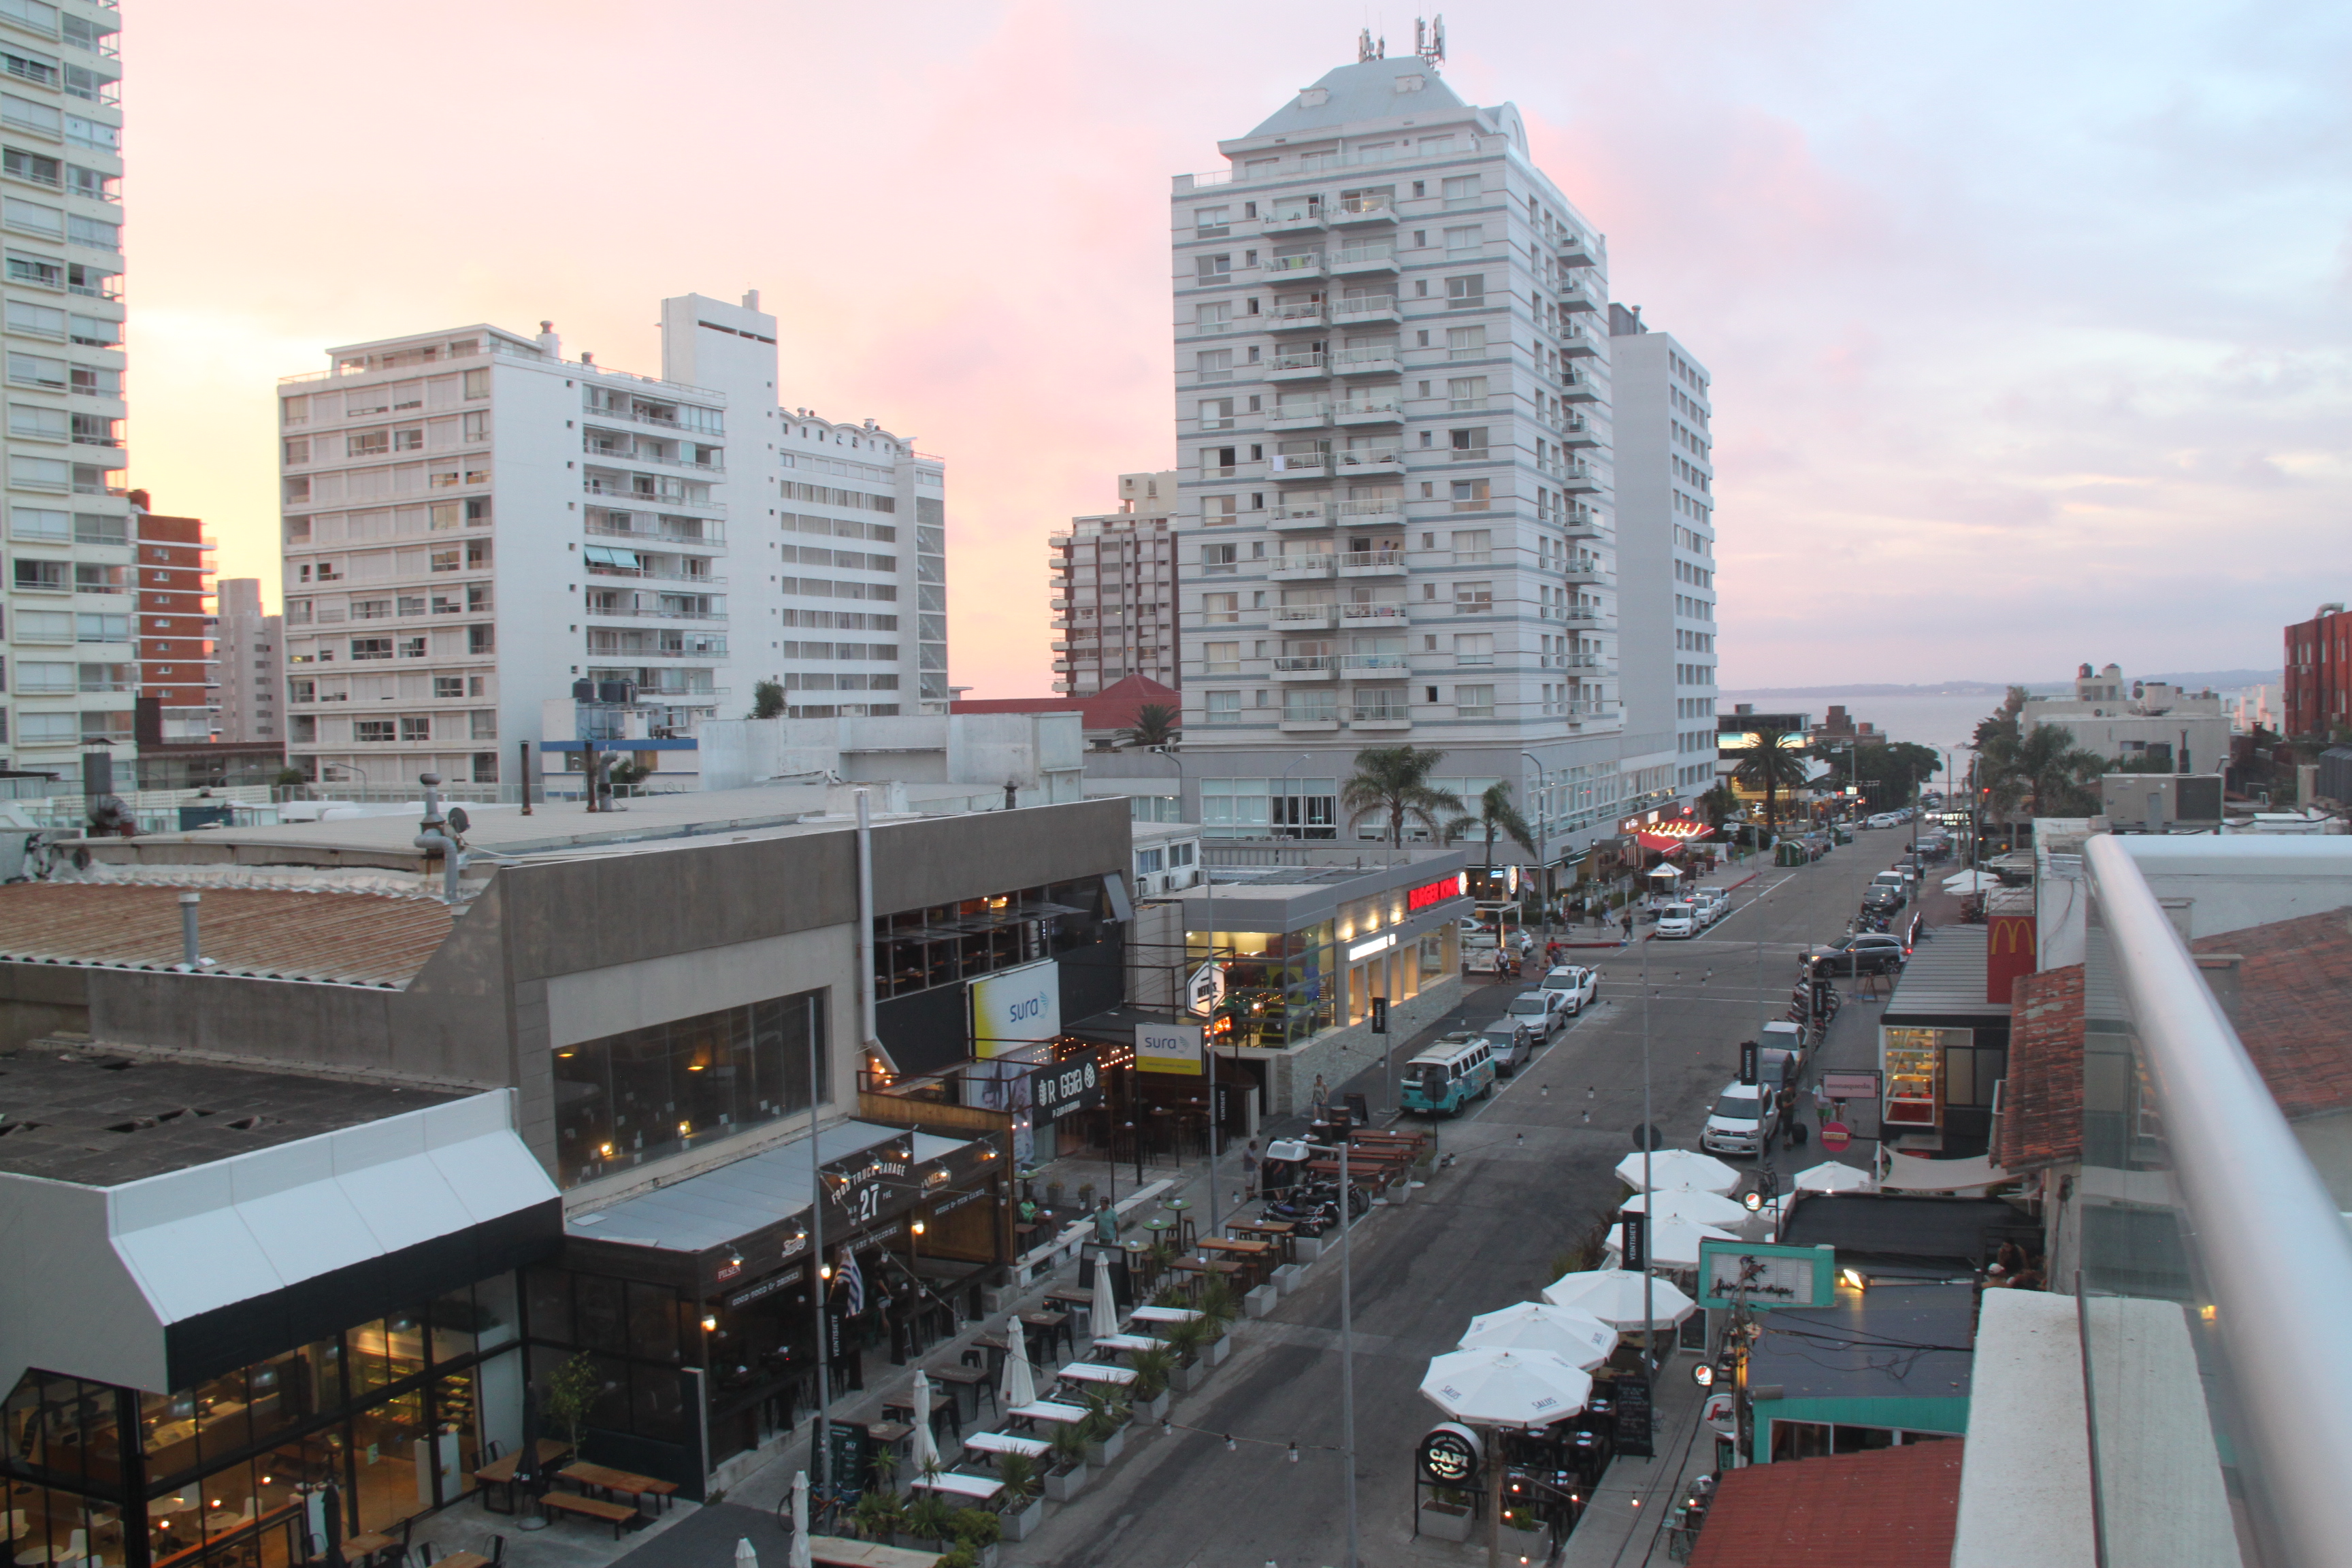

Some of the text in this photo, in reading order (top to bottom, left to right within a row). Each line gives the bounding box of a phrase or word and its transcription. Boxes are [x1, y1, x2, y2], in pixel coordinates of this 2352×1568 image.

[1409, 882, 1439, 911] BURGER
[1439, 876, 1459, 900] KING
[1010, 998, 1038, 1023] sura
[1145, 1037, 1176, 1049] sura
[832, 1162, 906, 1205] FOOD TRUCK GARAGE
[860, 1183, 880, 1222] 27
[718, 1265, 741, 1279] PILSEN
[732, 1294, 749, 1306] GOOD
[750, 1286, 768, 1298] FOOD
[768, 1282, 775, 1290] &
[832, 1314, 840, 1357] VEINTISIETE
[1441, 1385, 1461, 1400] SALUS
[1532, 1396, 1557, 1409] SALUS
[1429, 1448, 1469, 1468] CAPI
